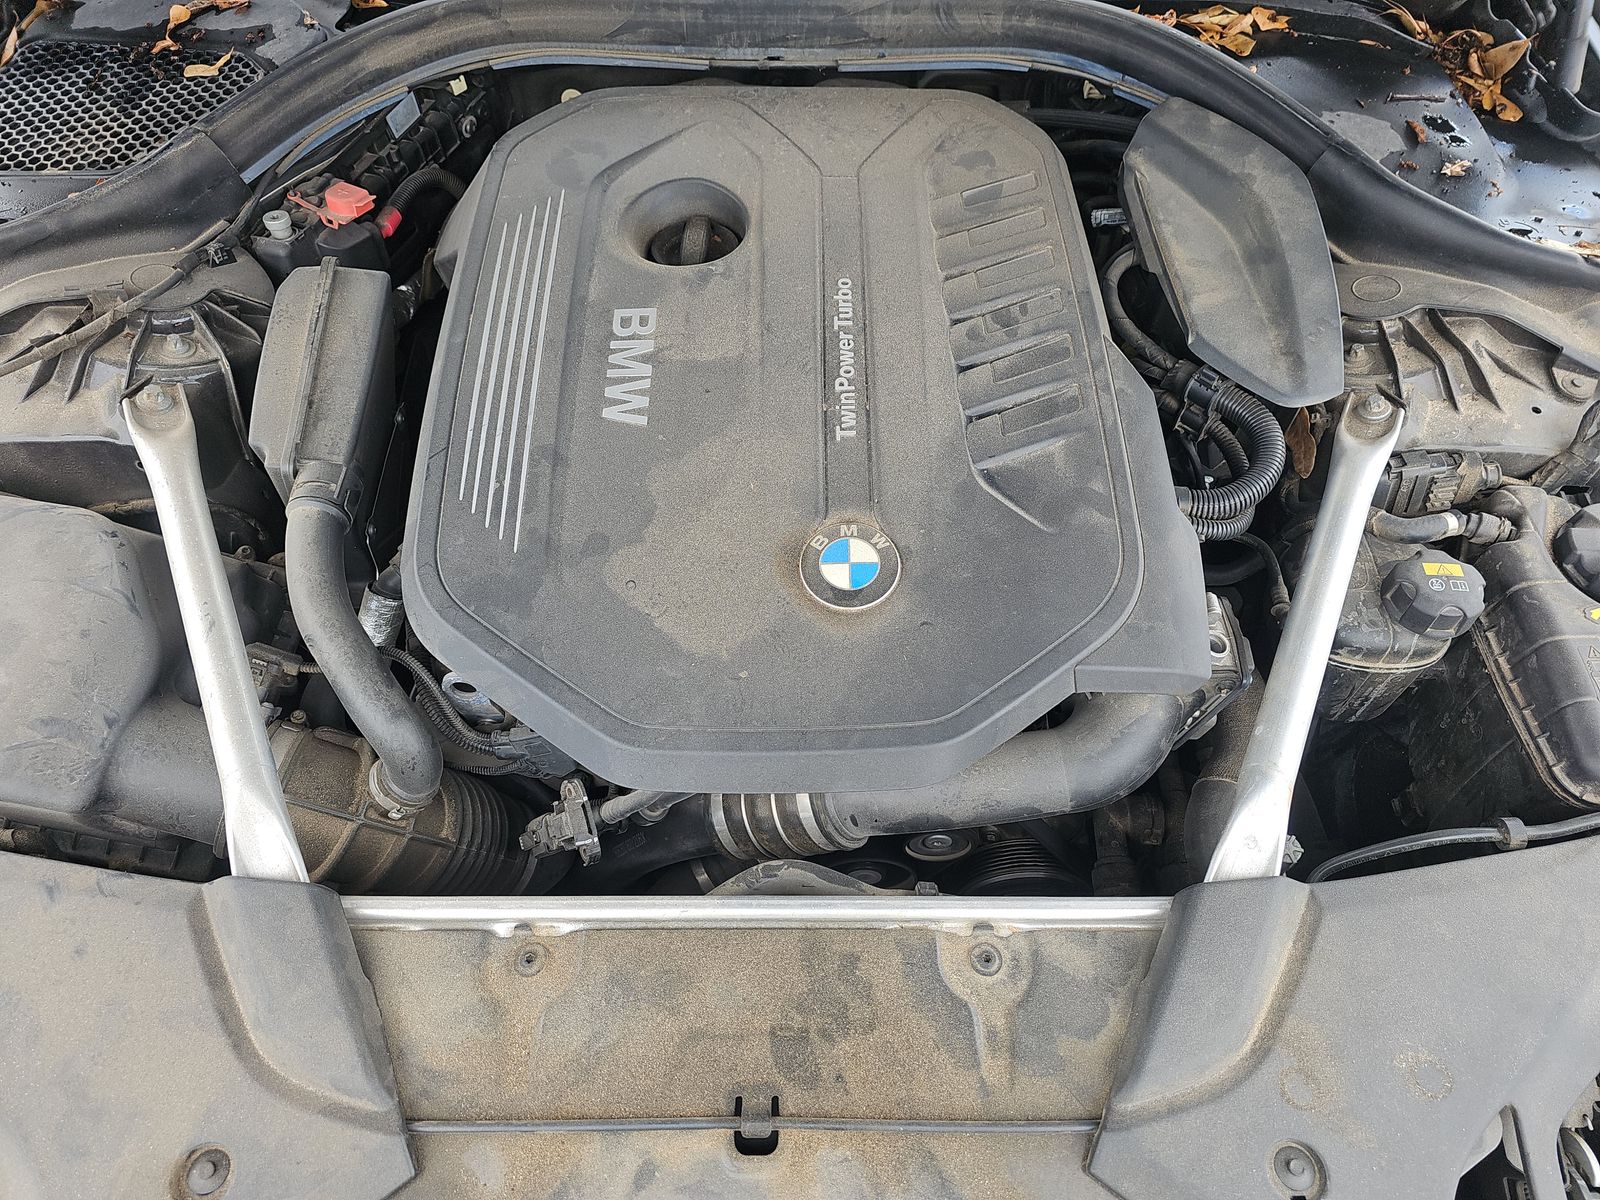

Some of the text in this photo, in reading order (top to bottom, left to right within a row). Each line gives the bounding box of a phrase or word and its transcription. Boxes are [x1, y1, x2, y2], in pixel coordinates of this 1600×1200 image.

[601, 307, 657, 425] BMW
[833, 277, 857, 441] TwinPower Turbo
[810, 524, 890, 550] BMW
